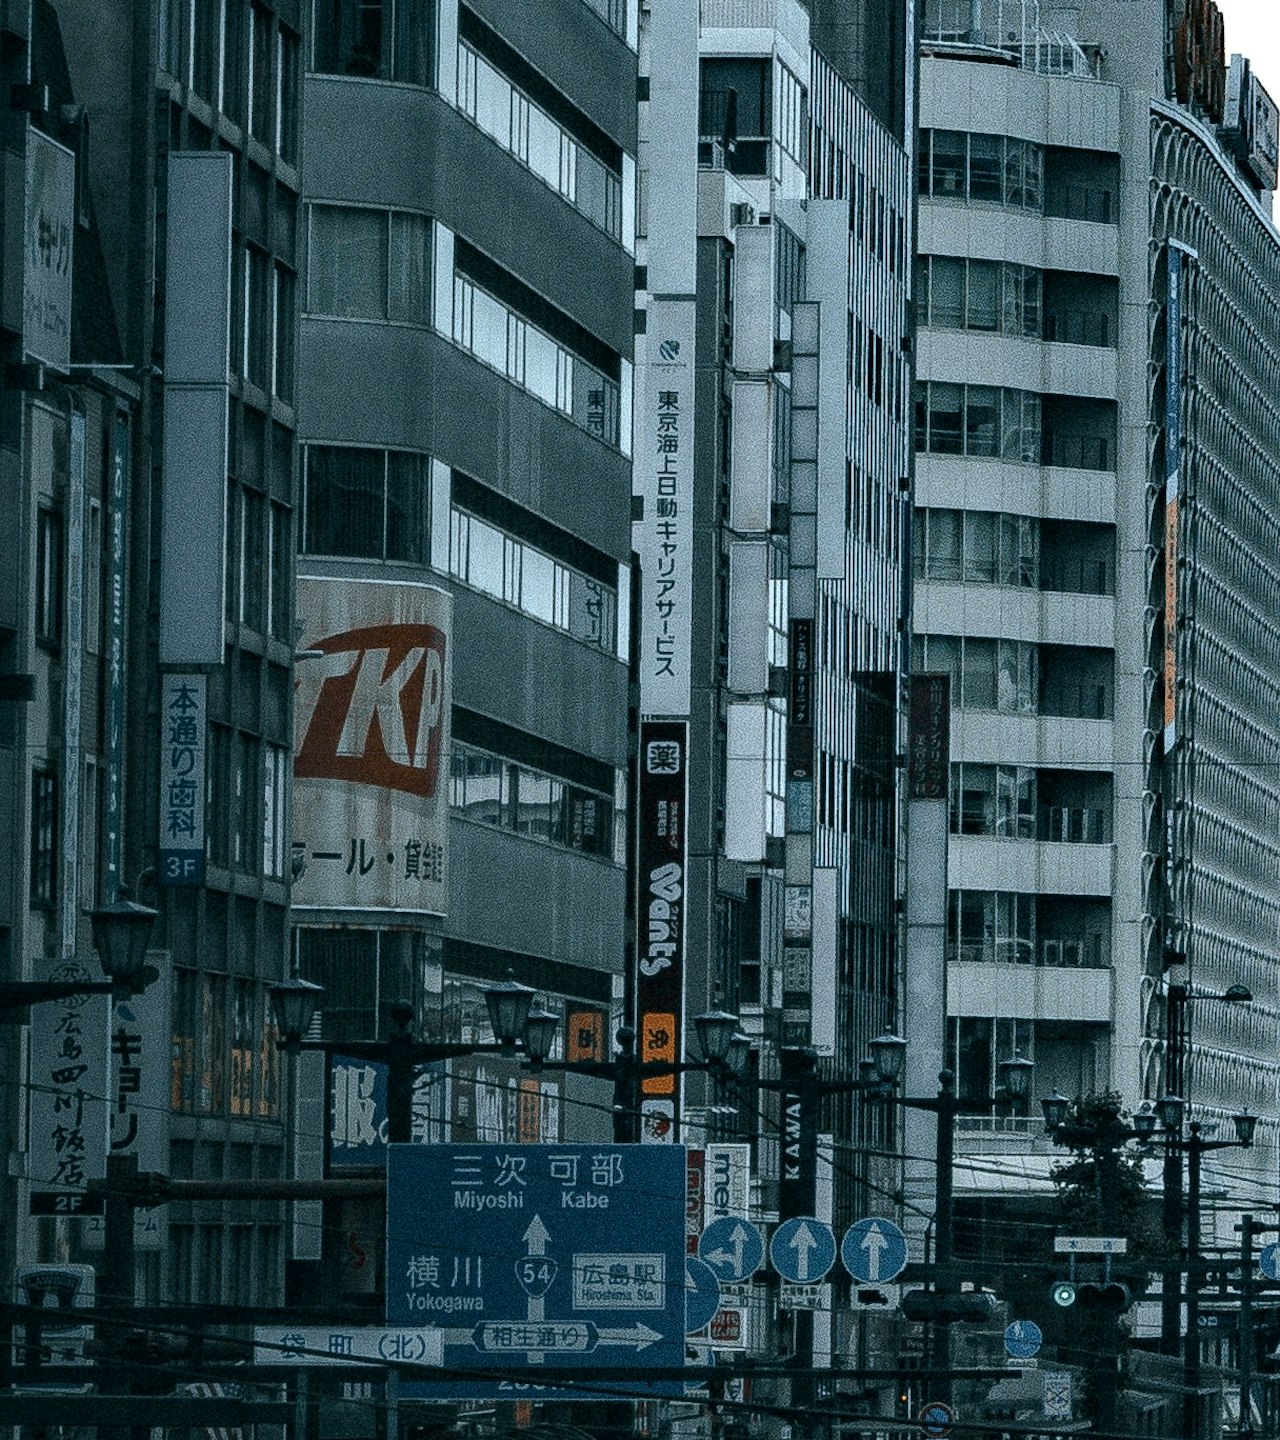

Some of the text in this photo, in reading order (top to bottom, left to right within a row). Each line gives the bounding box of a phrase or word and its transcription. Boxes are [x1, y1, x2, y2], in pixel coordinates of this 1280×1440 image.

[656, 390, 679, 677] 東京海上日動キャリアサービス
[167, 683, 200, 838] 本通り歯科
[651, 744, 676, 772] 薬
[167, 857, 196, 877] 3F
[640, 863, 682, 976] Wants
[53, 1012, 88, 1183] 広島四川飯店
[450, 1153, 625, 1188] 三次 可部
[55, 1196, 83, 1210] 2F
[454, 1190, 610, 1212] Miyoshi Kabe
[406, 1255, 484, 1289] 横川
[522, 1263, 550, 1284] 54
[582, 1263, 656, 1286] 広島駅
[405, 1292, 484, 1314] Yokogawa
[491, 1326, 580, 1348] 相生通り
